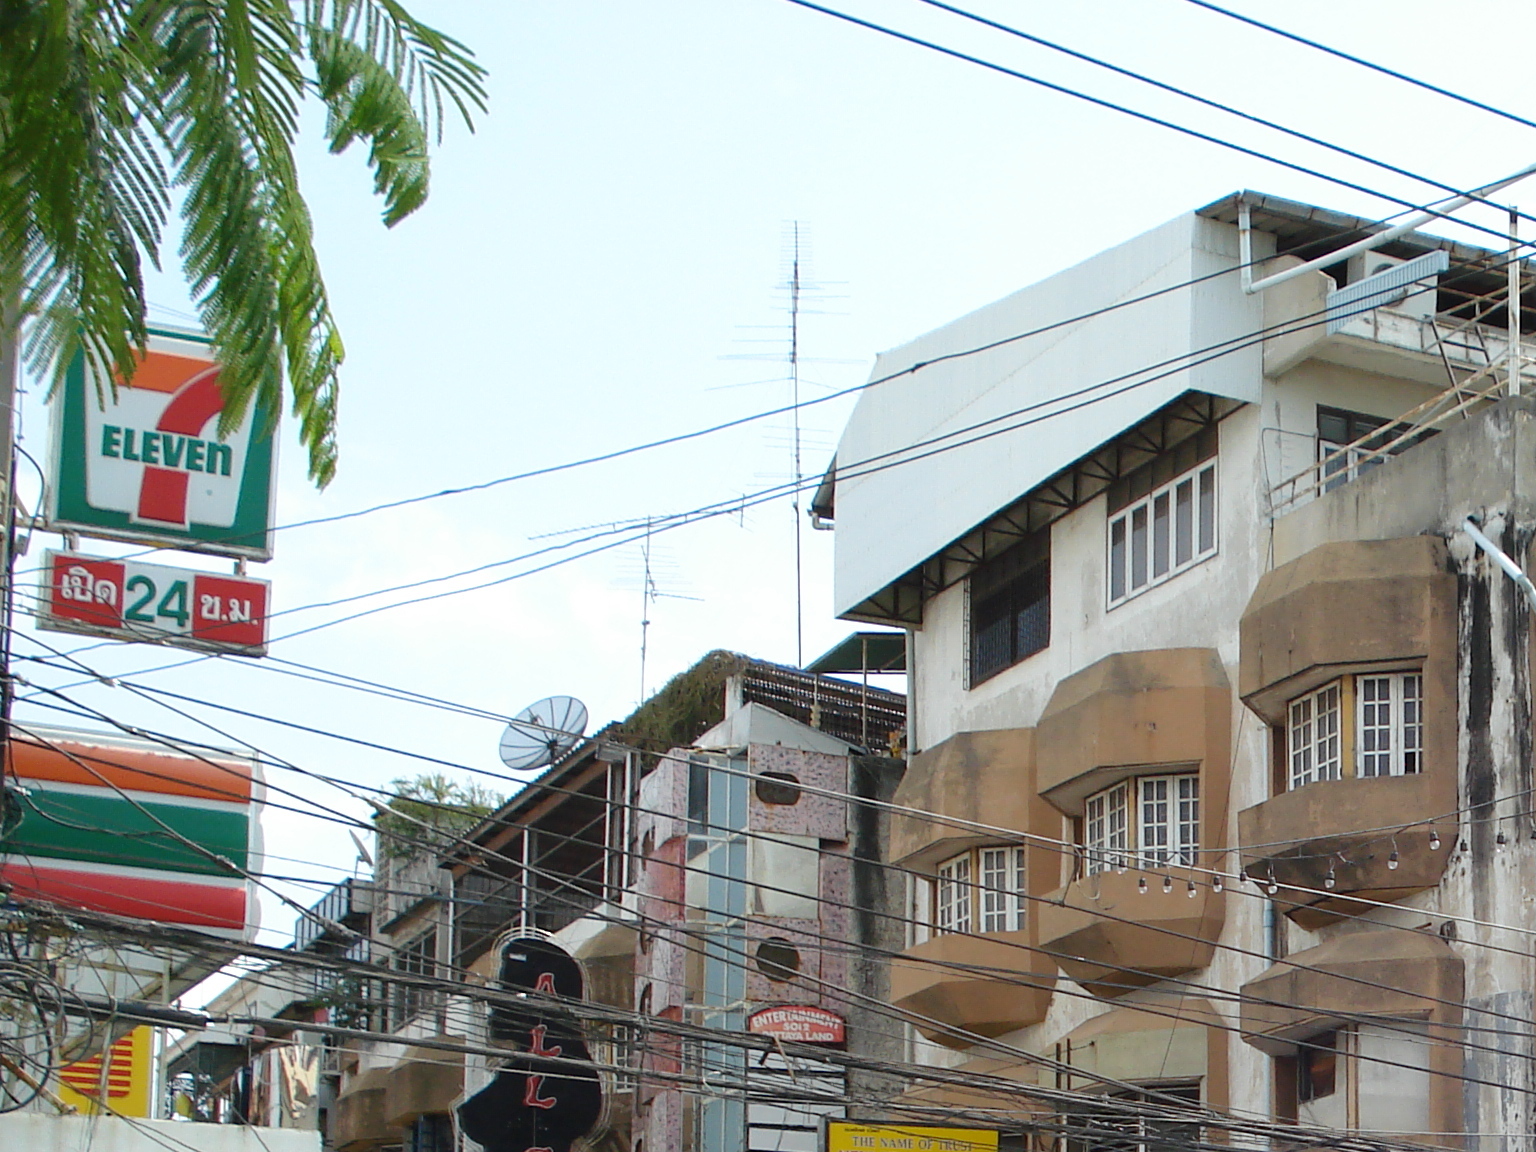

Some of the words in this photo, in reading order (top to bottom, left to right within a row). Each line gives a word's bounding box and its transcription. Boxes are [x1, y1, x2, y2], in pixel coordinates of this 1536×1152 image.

[61, 566, 117, 606] เปิด
[125, 575, 189, 628] 24
[805, 1032, 834, 1041] LAND
[853, 1136, 875, 1147] THE
[880, 1138, 914, 1149] NAME
[918, 1139, 935, 1150] OF
